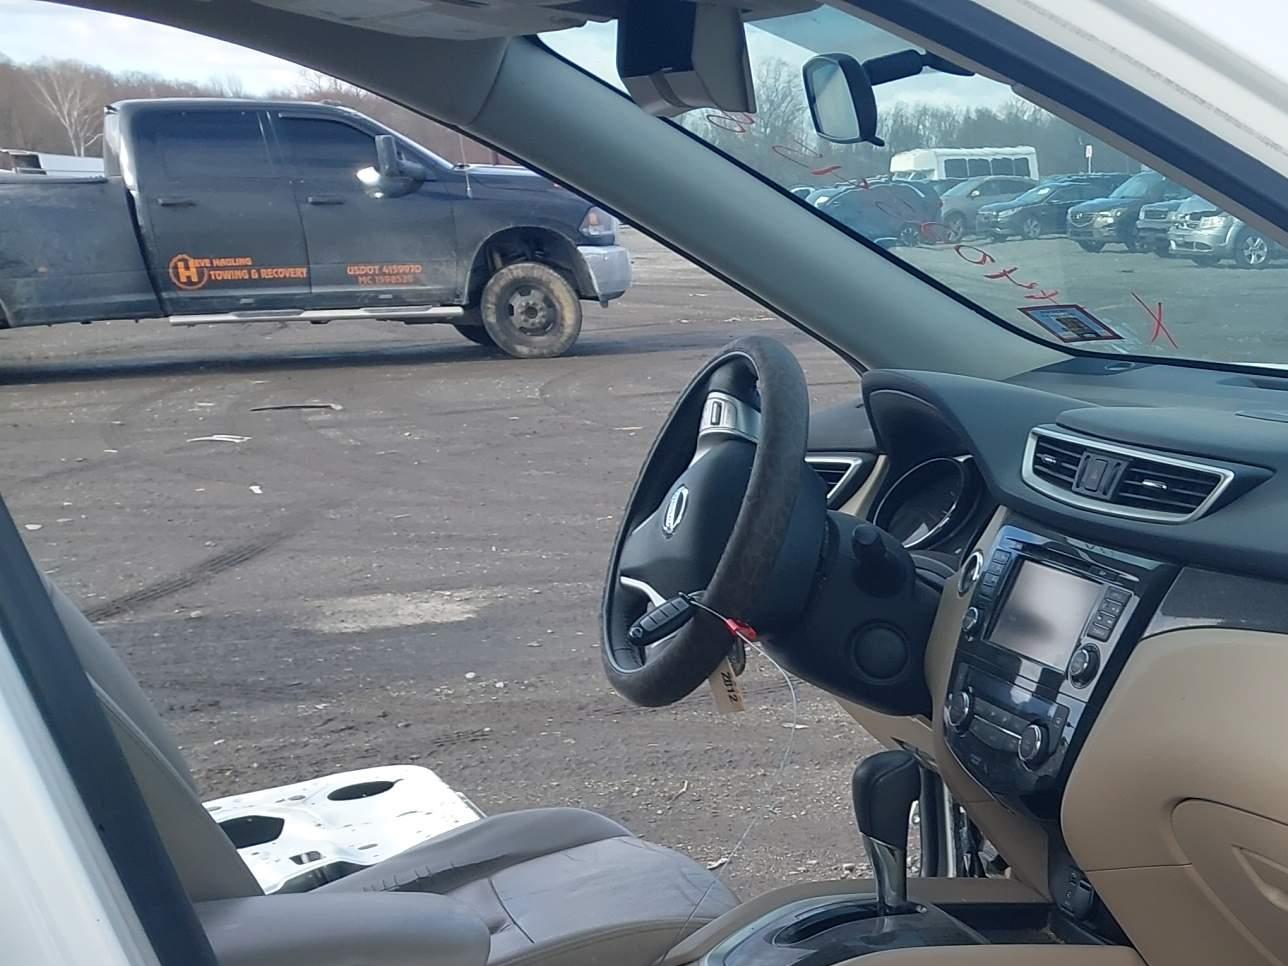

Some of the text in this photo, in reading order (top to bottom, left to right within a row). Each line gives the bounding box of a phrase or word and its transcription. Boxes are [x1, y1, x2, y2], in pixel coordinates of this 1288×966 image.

[209, 269, 249, 280] TOWING
[260, 267, 307, 279] RECOVERY
[347, 264, 379, 275] USDOT
